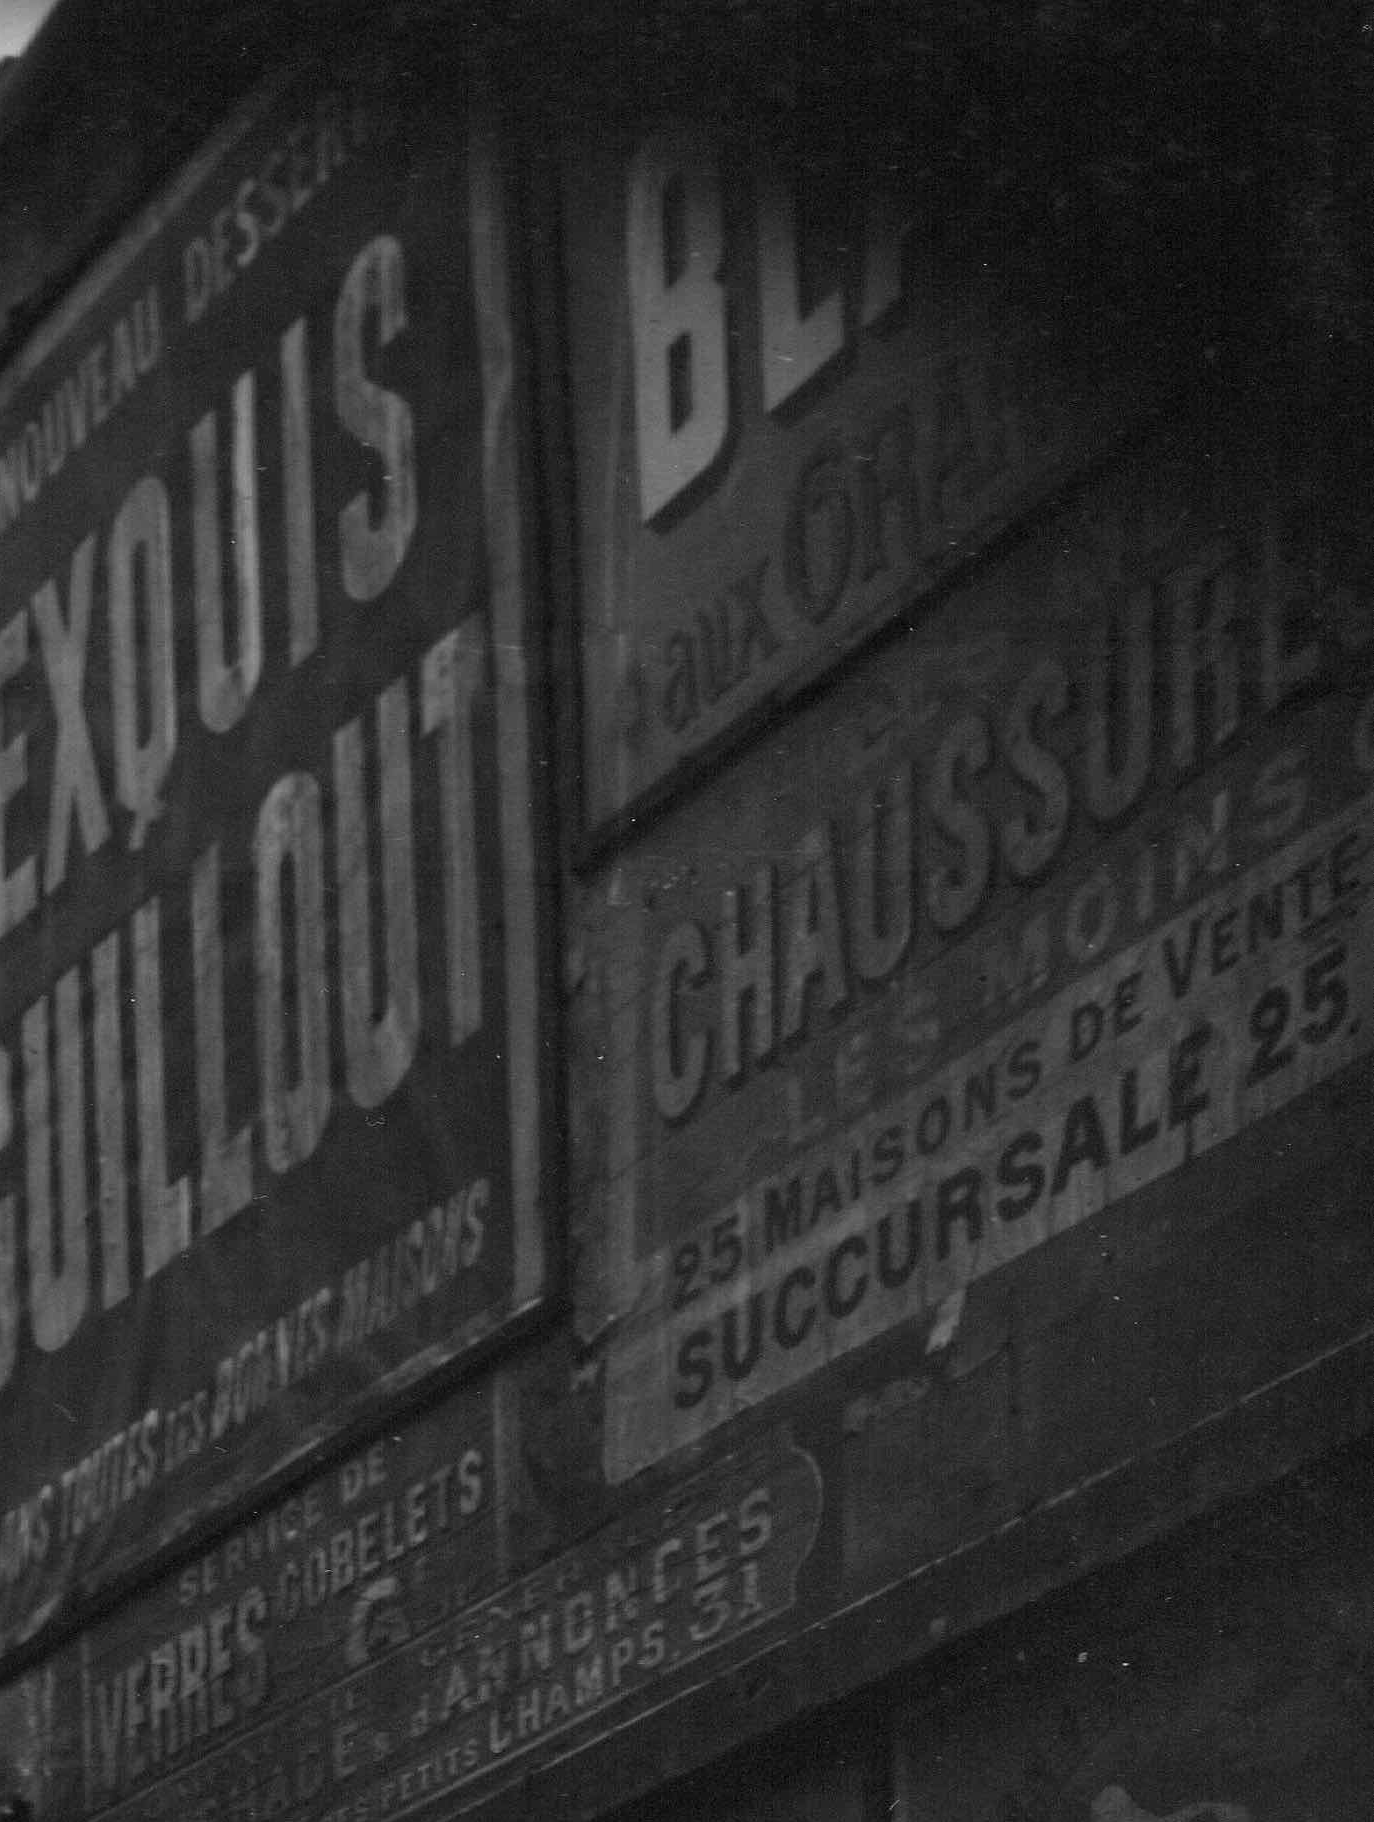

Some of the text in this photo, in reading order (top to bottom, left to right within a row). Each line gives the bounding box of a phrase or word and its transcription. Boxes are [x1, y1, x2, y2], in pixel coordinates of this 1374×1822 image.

[671, 833, 1362, 1311] 25 MAISONS DE VENTE
[672, 1015, 1213, 1410] SUCCURSALE
[339, 1440, 390, 1506] DE
[688, 1561, 764, 1643] 31
